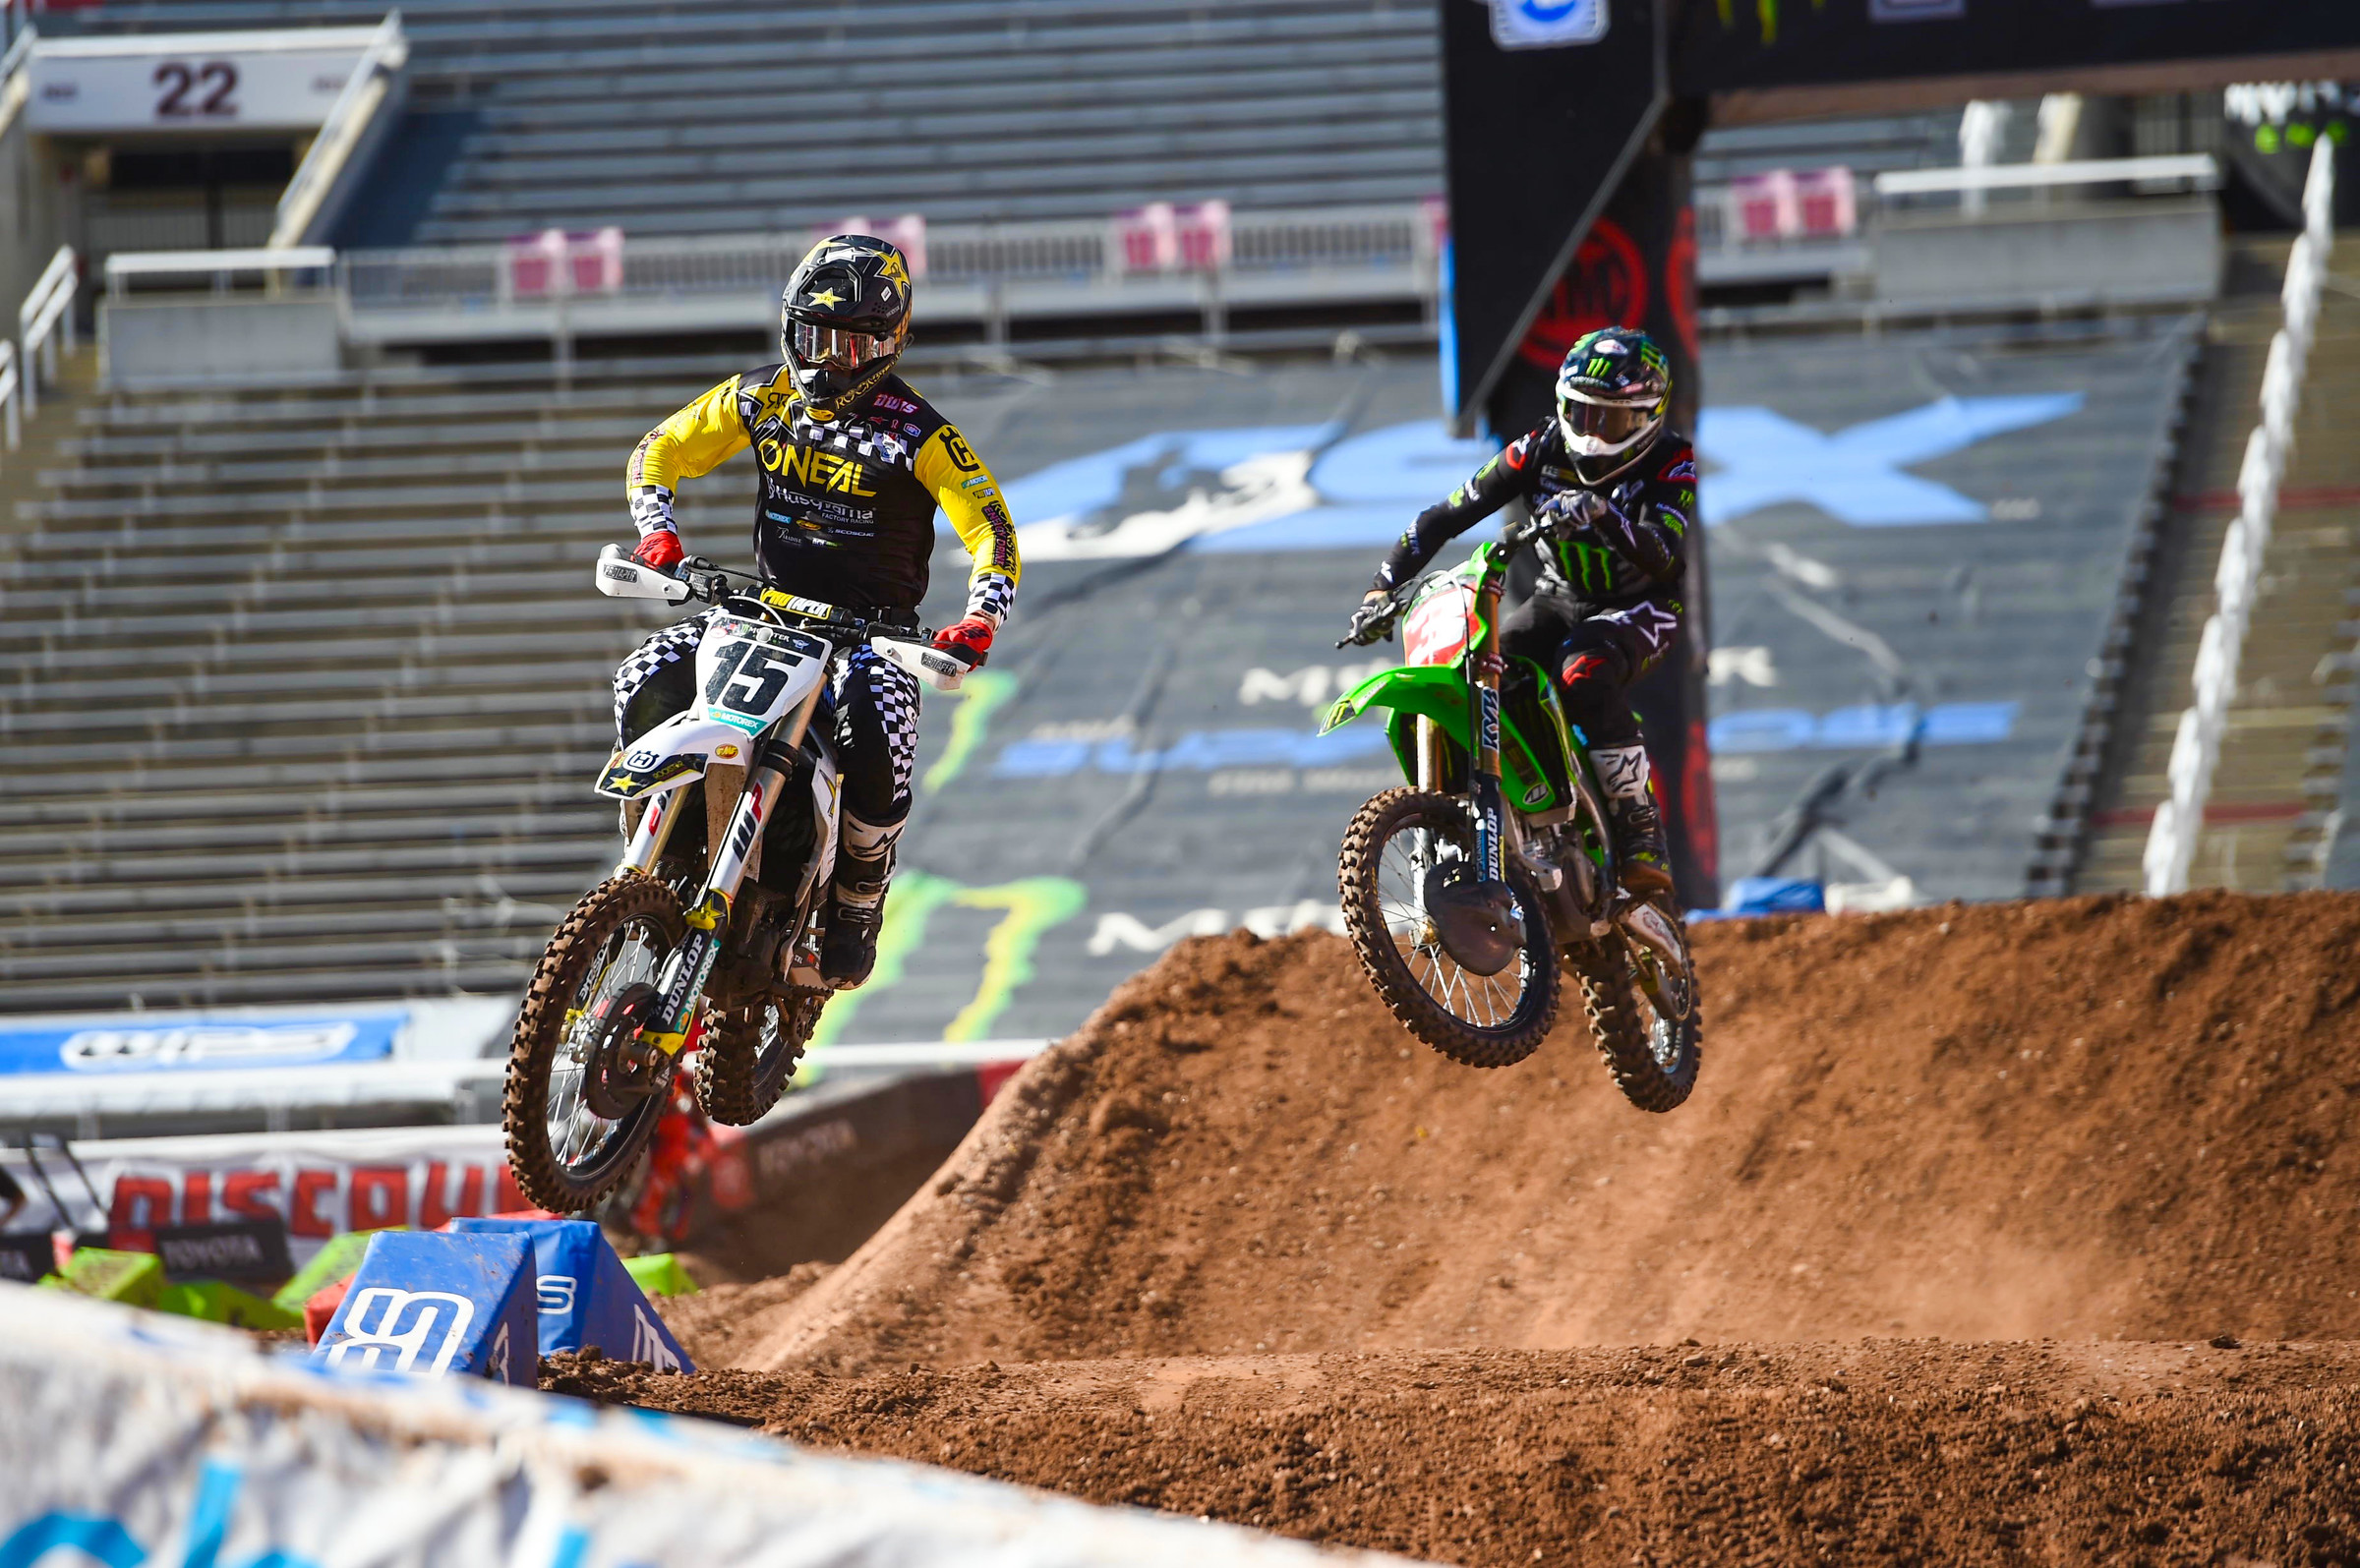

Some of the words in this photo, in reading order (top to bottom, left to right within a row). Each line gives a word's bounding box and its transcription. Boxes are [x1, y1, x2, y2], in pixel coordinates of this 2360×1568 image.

[152, 61, 239, 117] 22
[775, 485, 874, 520] Husqvarna
[822, 512, 850, 523] FACTORY
[761, 588, 828, 617] PROTAPER
[705, 640, 803, 716] 15
[721, 713, 759, 728] MOTOREX
[716, 745, 738, 758] FMF
[1487, 807, 1499, 881] DUNLOP
[661, 933, 703, 1025] DUNLOP
[684, 942, 719, 1013] MOTOREX
[159, 1234, 265, 1269] TOYOTA
